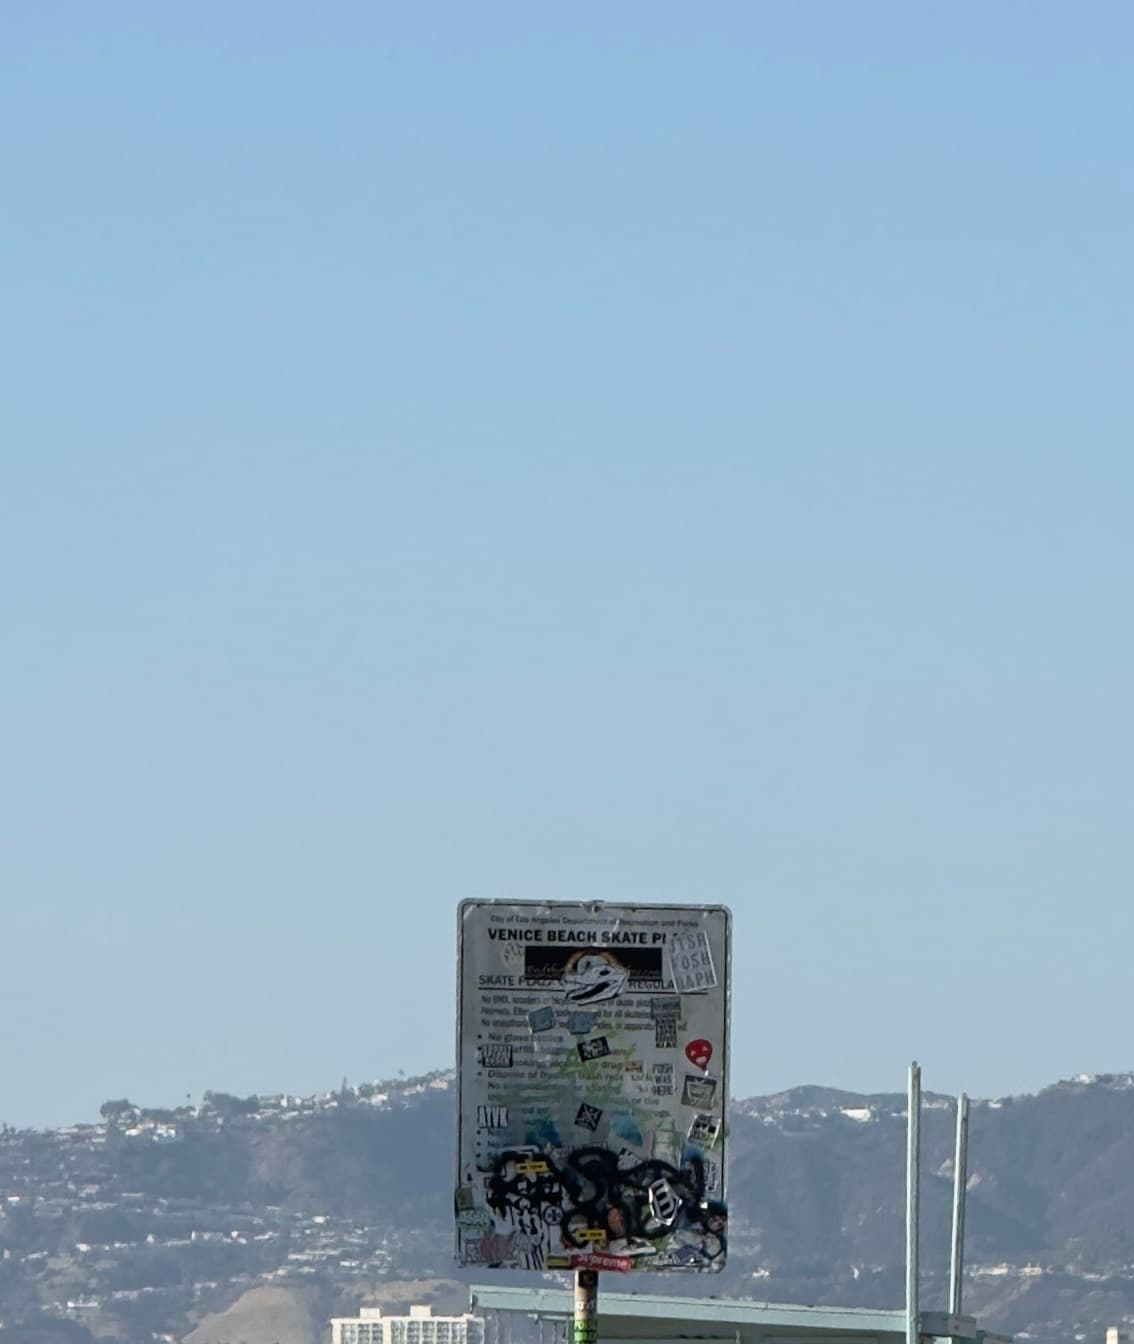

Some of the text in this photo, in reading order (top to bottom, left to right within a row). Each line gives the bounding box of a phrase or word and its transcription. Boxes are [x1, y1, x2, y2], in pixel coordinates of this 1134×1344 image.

[488, 928, 543, 942] VENICE
[547, 929, 597, 943] BEACH
[601, 931, 648, 945] SKATE
[479, 974, 514, 986] SKATE
